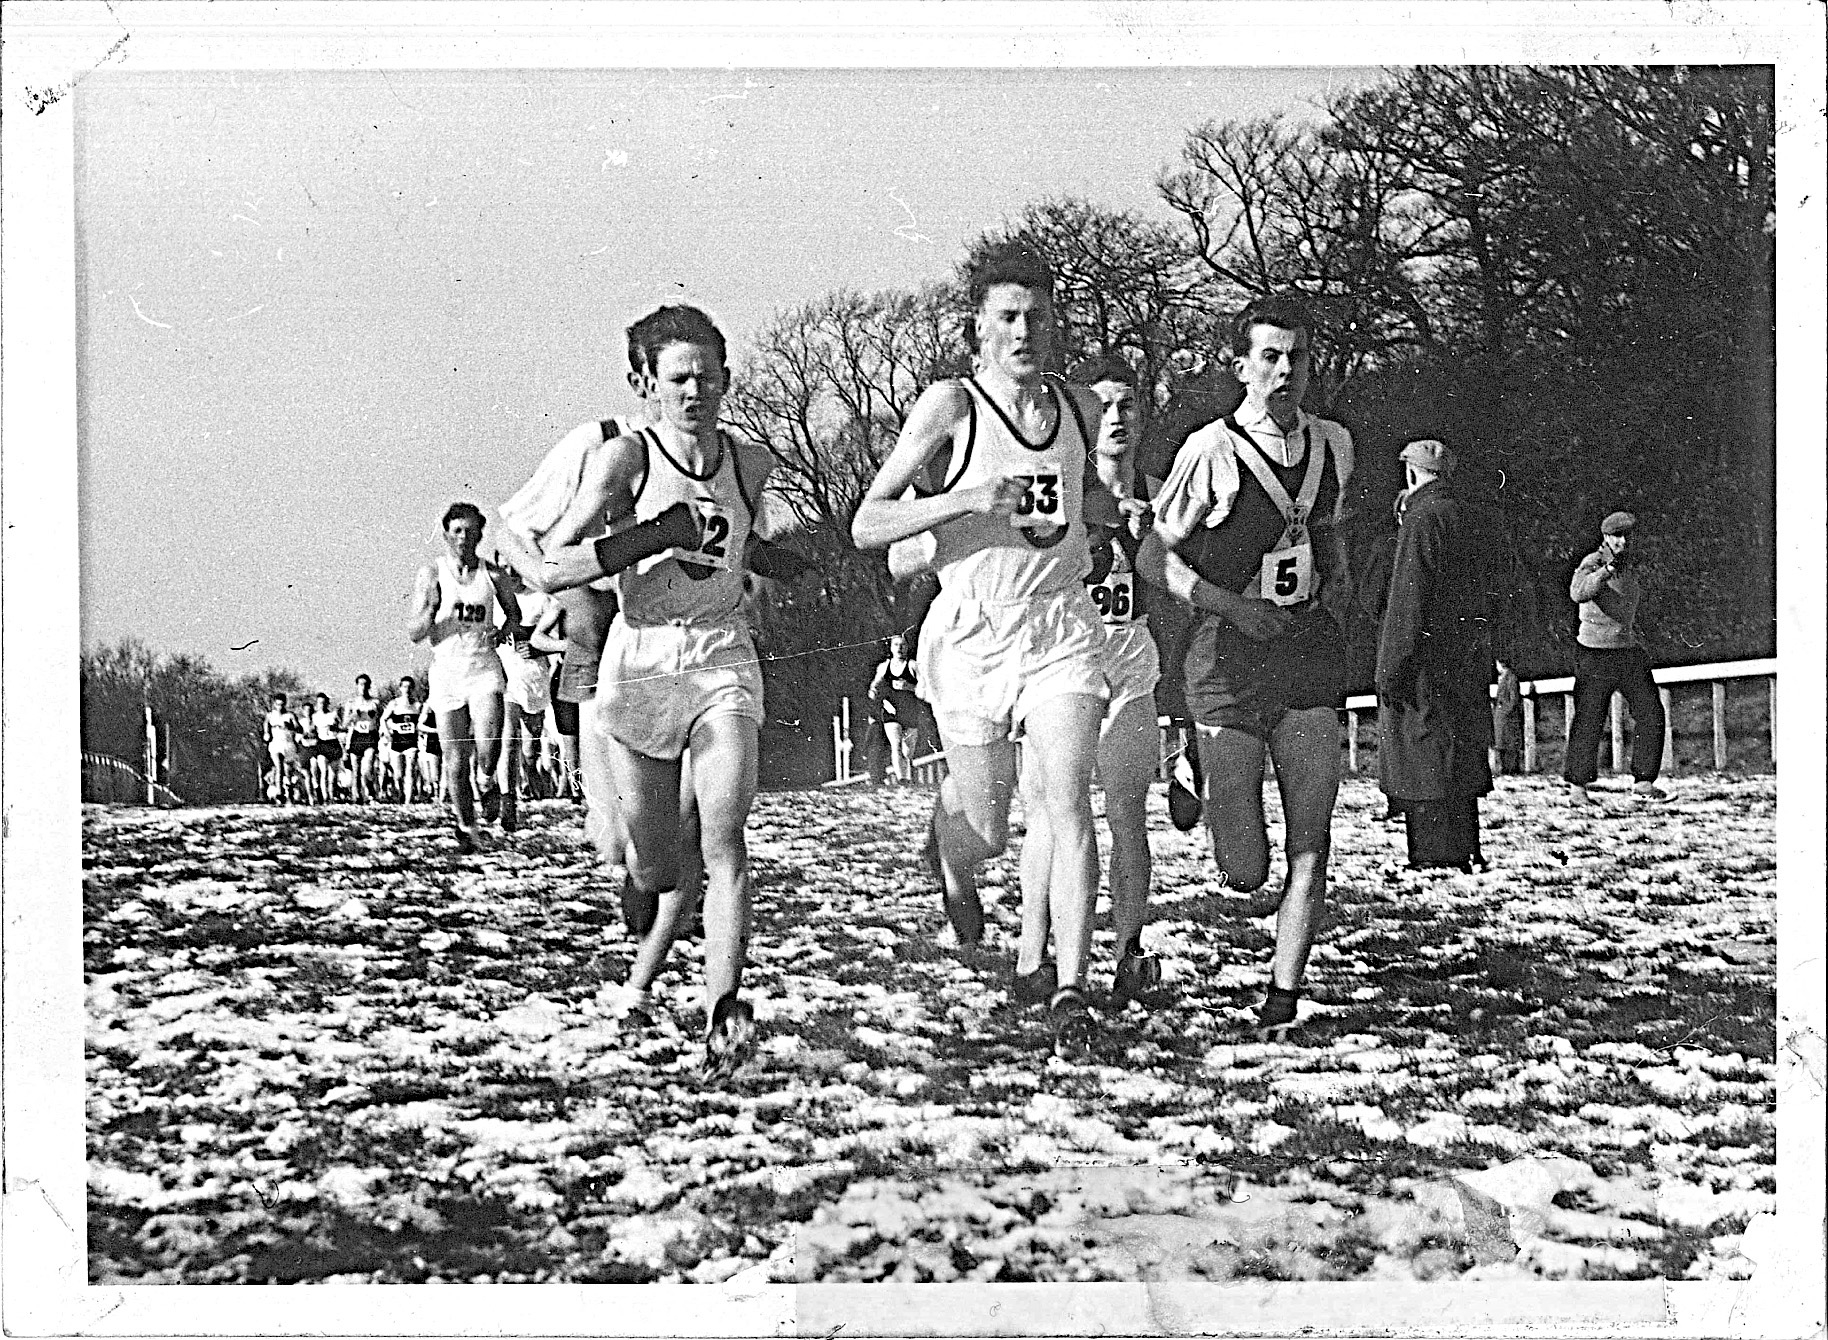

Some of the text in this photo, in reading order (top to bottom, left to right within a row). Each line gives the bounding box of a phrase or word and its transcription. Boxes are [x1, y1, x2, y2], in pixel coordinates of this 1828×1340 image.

[1274, 556, 1299, 596] 5
[454, 602, 486, 623] 129
[1091, 583, 1130, 617] 96
